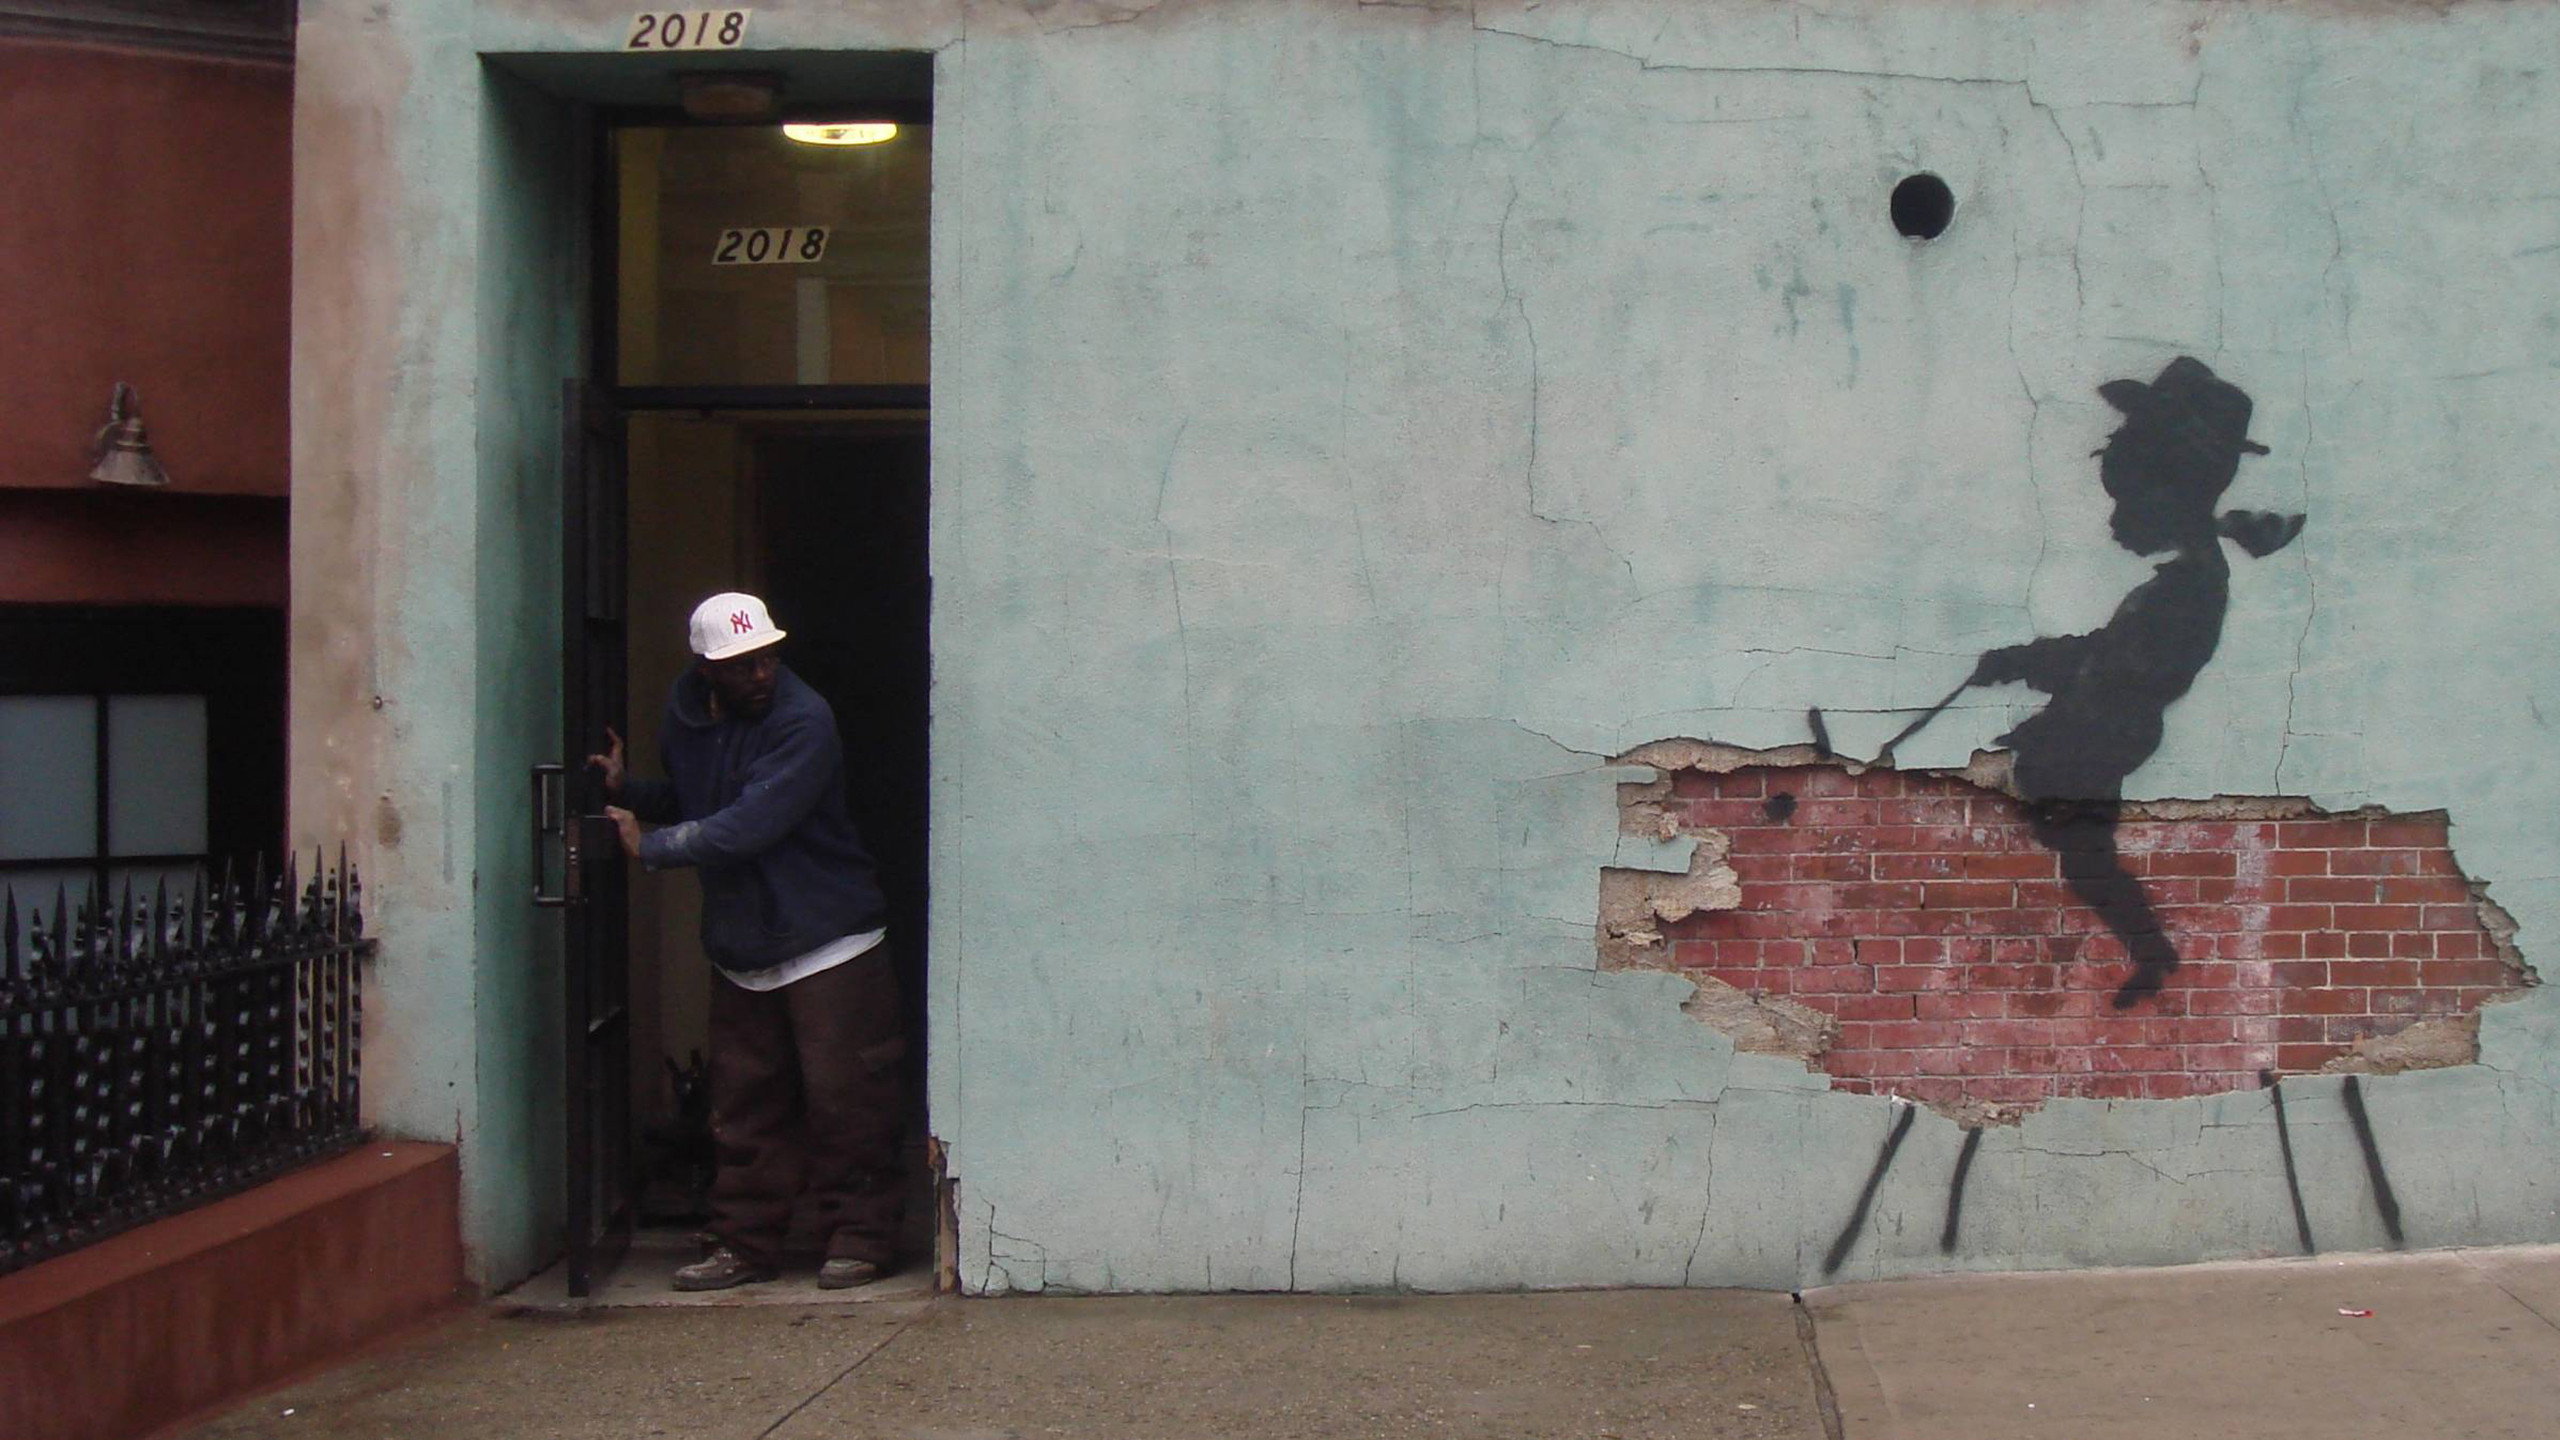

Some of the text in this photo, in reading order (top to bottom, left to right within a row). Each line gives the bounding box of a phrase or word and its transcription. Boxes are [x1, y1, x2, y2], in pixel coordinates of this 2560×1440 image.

[628, 11, 745, 48] 2018
[716, 228, 825, 263] 2018
[730, 610, 754, 634] NY
